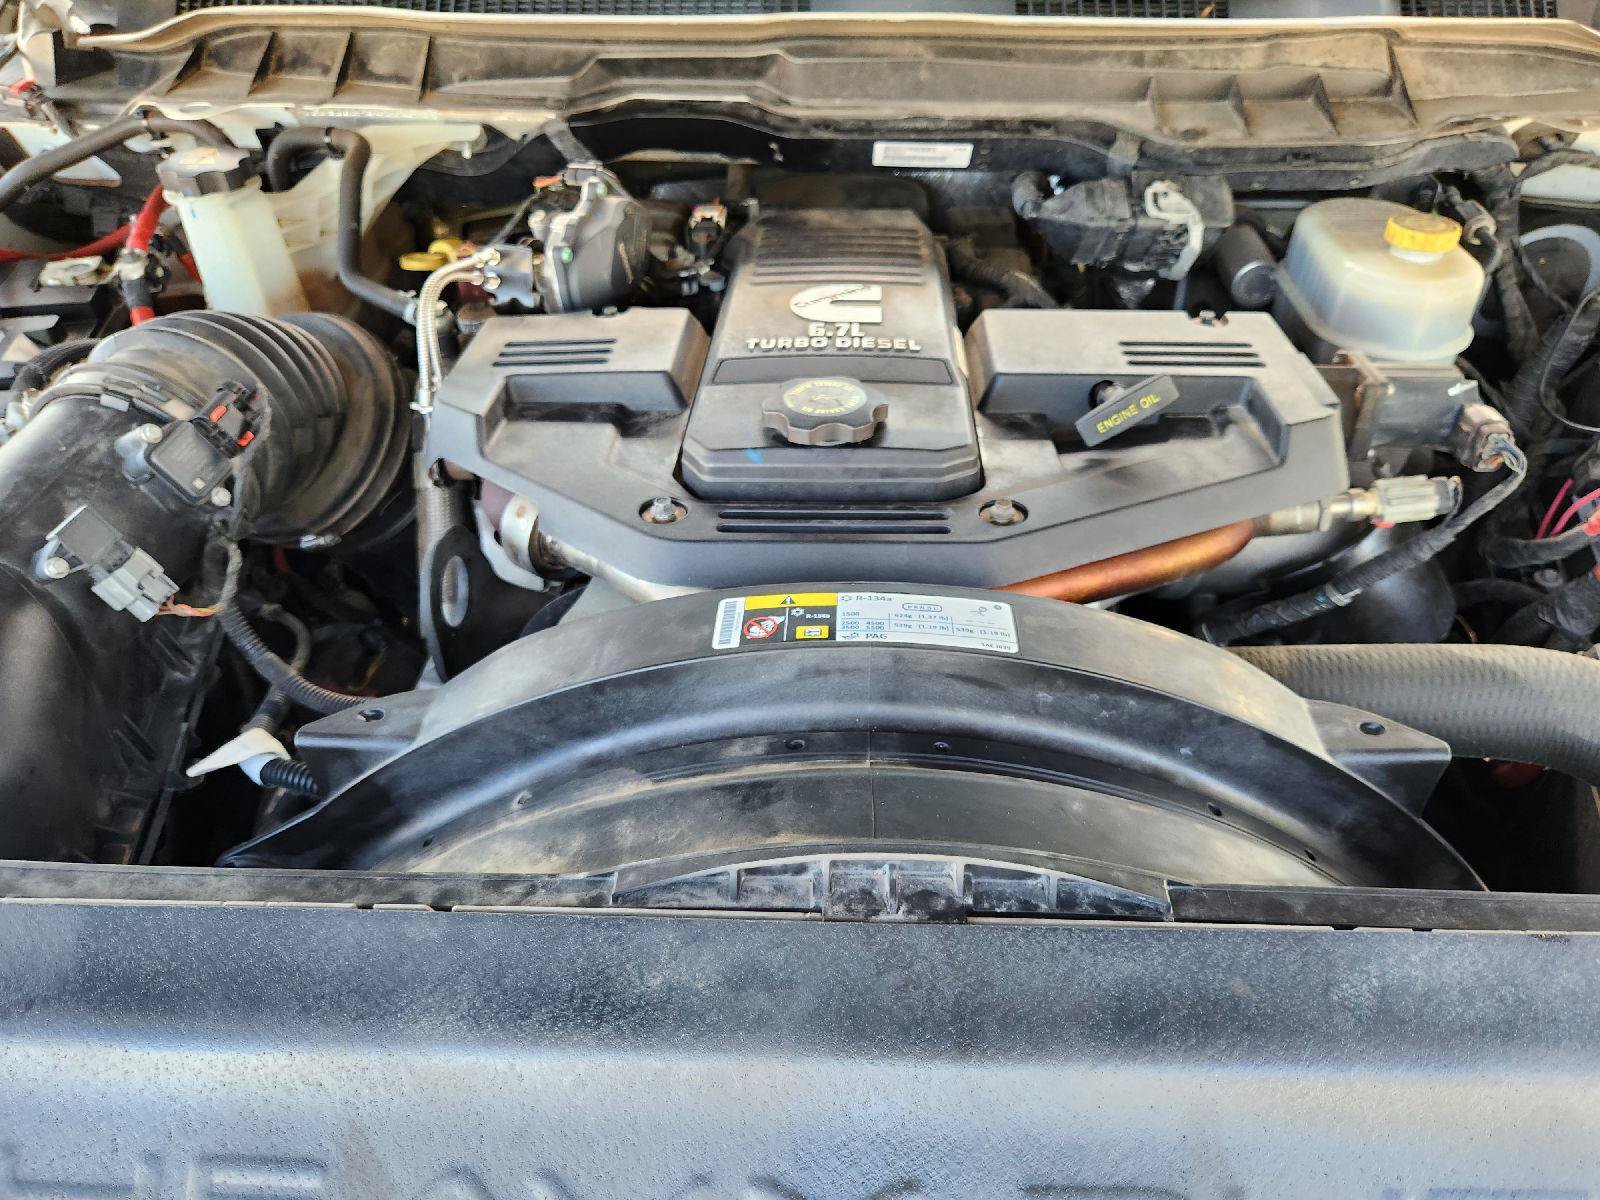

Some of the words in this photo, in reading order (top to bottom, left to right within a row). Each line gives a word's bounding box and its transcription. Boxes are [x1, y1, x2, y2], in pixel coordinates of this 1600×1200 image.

[808, 322, 865, 337] 6.7L
[745, 336, 828, 351] TURBO
[835, 336, 921, 352] DIESEL
[1096, 404, 1138, 433] ENGINE
[1140, 394, 1161, 409] OIL
